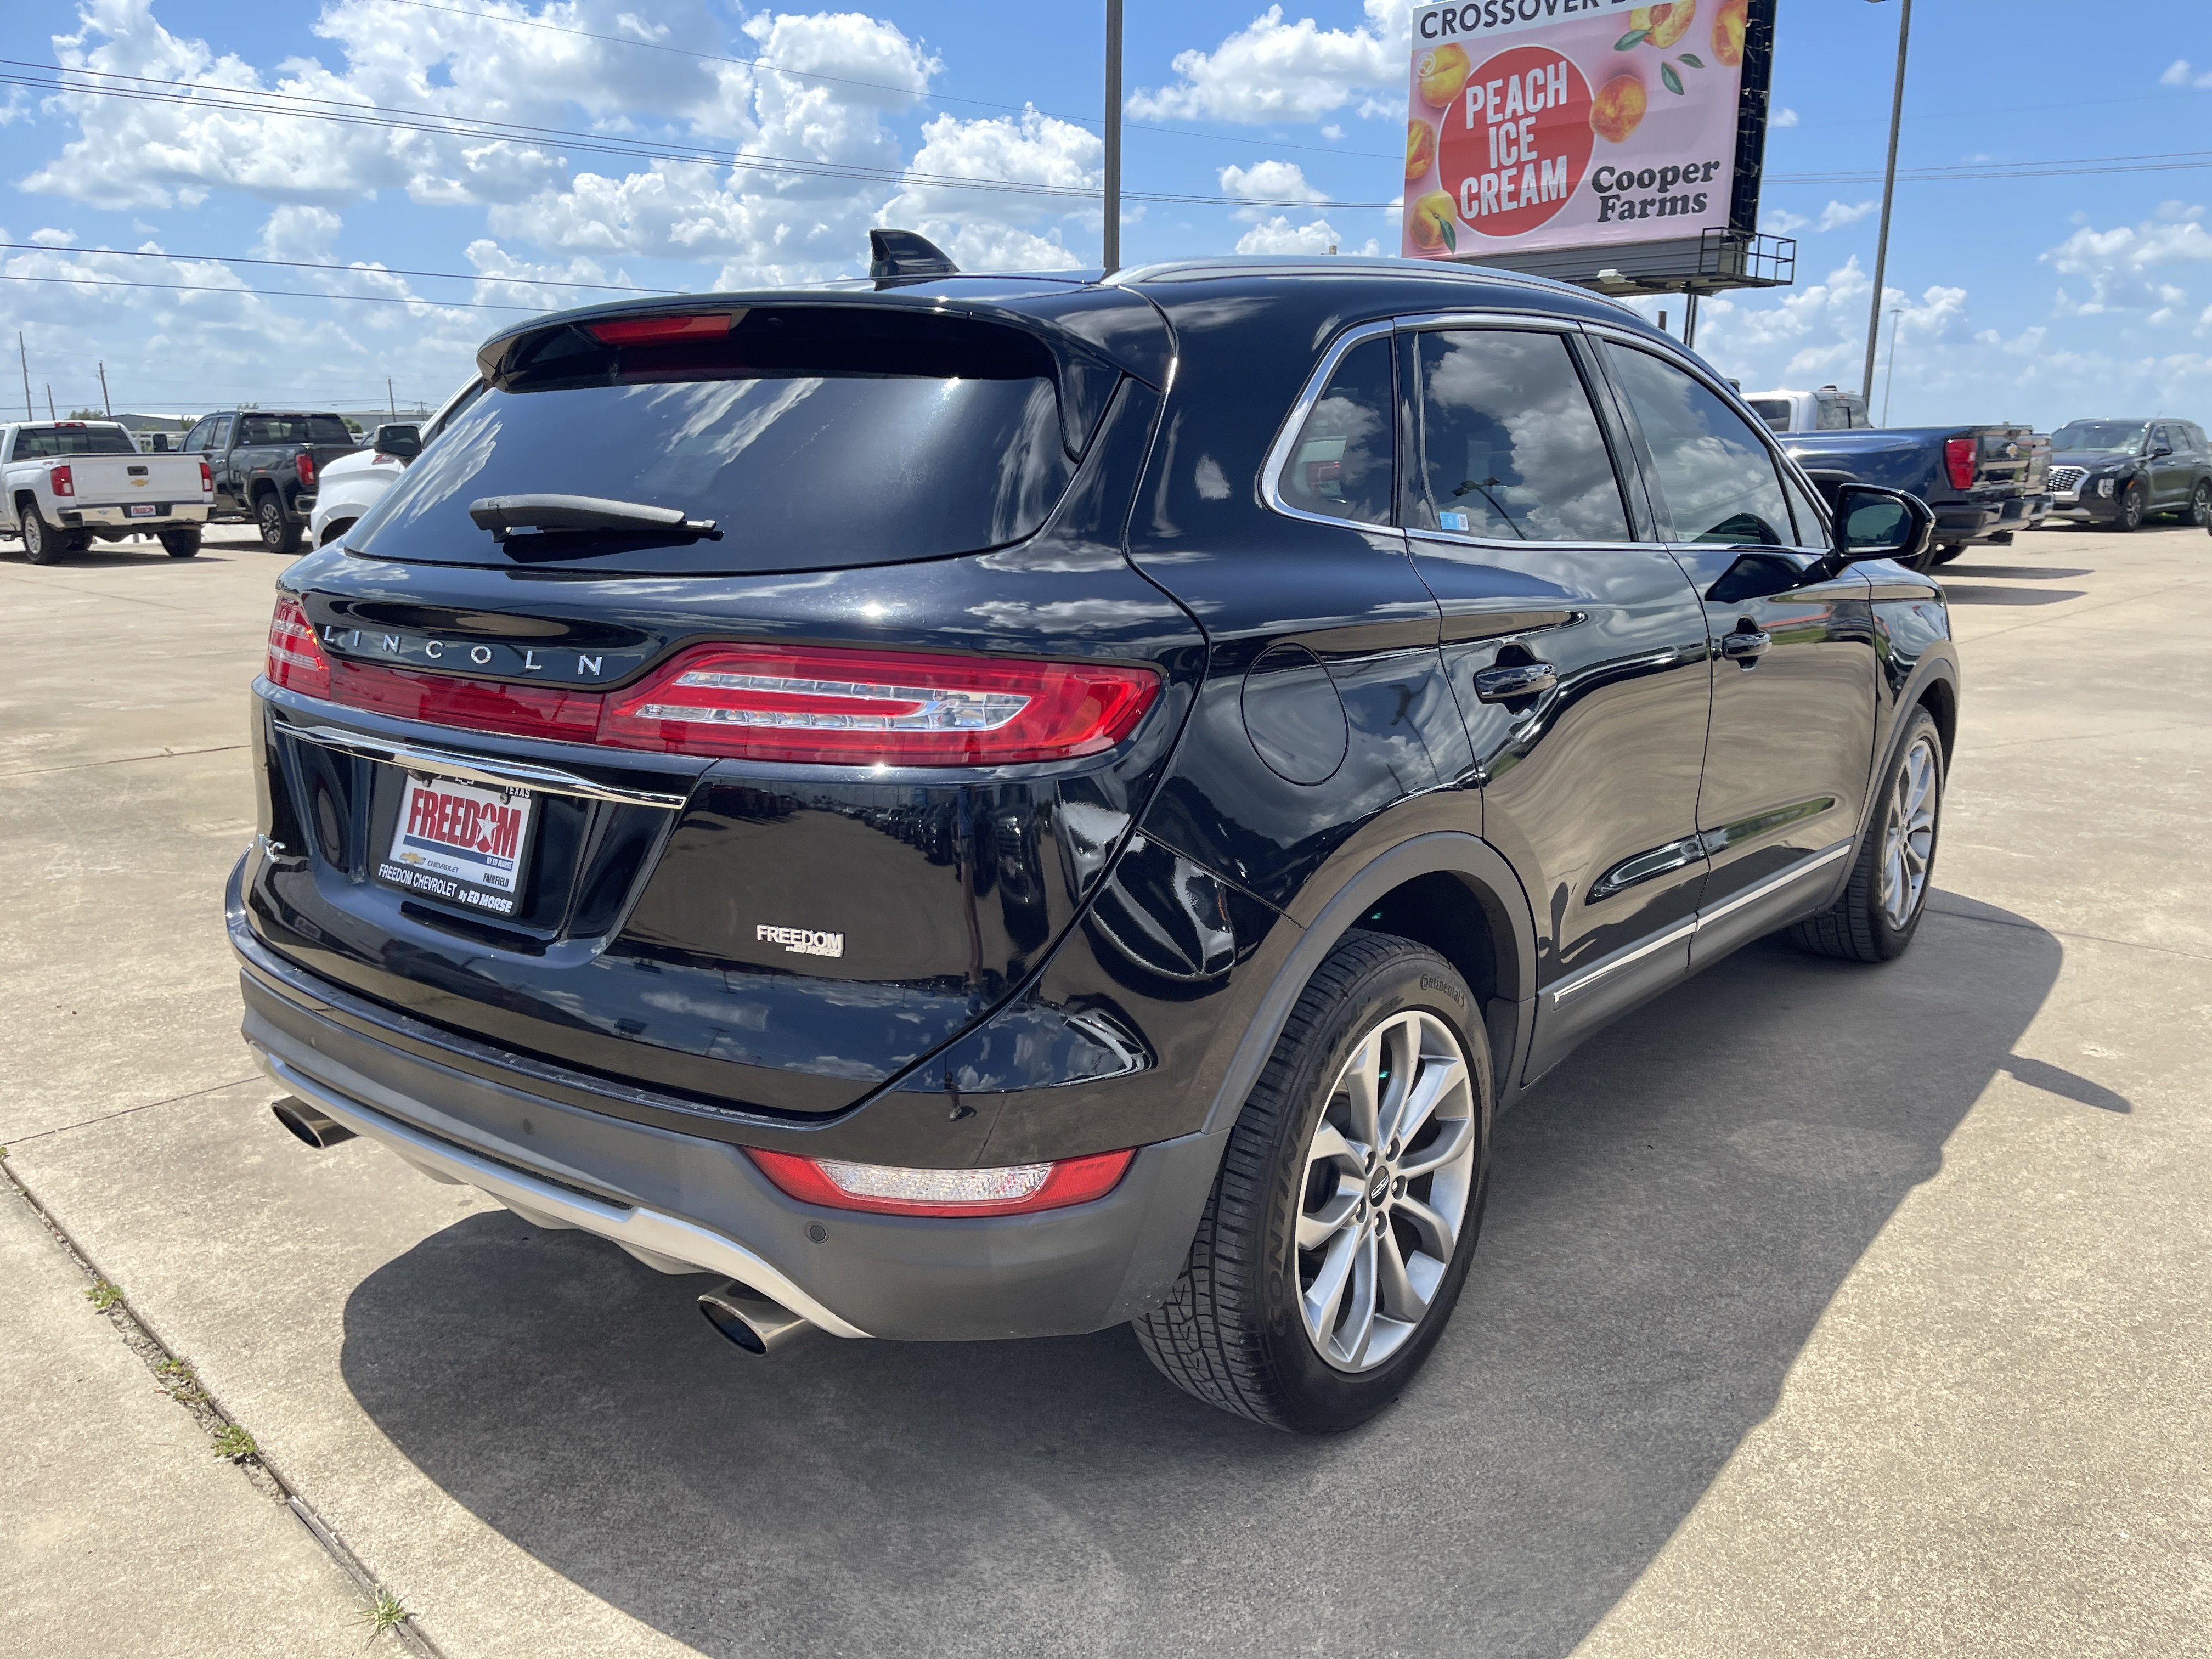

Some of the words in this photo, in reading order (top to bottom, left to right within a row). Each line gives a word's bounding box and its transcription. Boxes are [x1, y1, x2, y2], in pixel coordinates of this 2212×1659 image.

[1465, 61, 1567, 129] PEACH
[1488, 116, 1537, 169] ICE
[1460, 155, 1567, 219] CREAM
[1592, 160, 1720, 194] Cooper
[1597, 191, 1707, 222] Farms
[324, 625, 602, 676] LINCOLN
[505, 786, 531, 798] TEXAS
[407, 788, 522, 859] FREEDOM
[427, 860, 460, 873] CHEVROLET
[483, 872, 509, 888] FAIRFIELD
[493, 859, 499, 867] ED
[498, 860, 512, 870] MORSE
[378, 864, 413, 885] FREEDOM
[413, 873, 458, 898] CHEVROLET
[458, 890, 468, 902] By
[467, 890, 481, 905] ED
[479, 893, 514, 913] MORSE
[757, 924, 844, 949] FREEDOM
[806, 945, 843, 958] MORSE
[1420, 973, 1461, 1005] Continental
